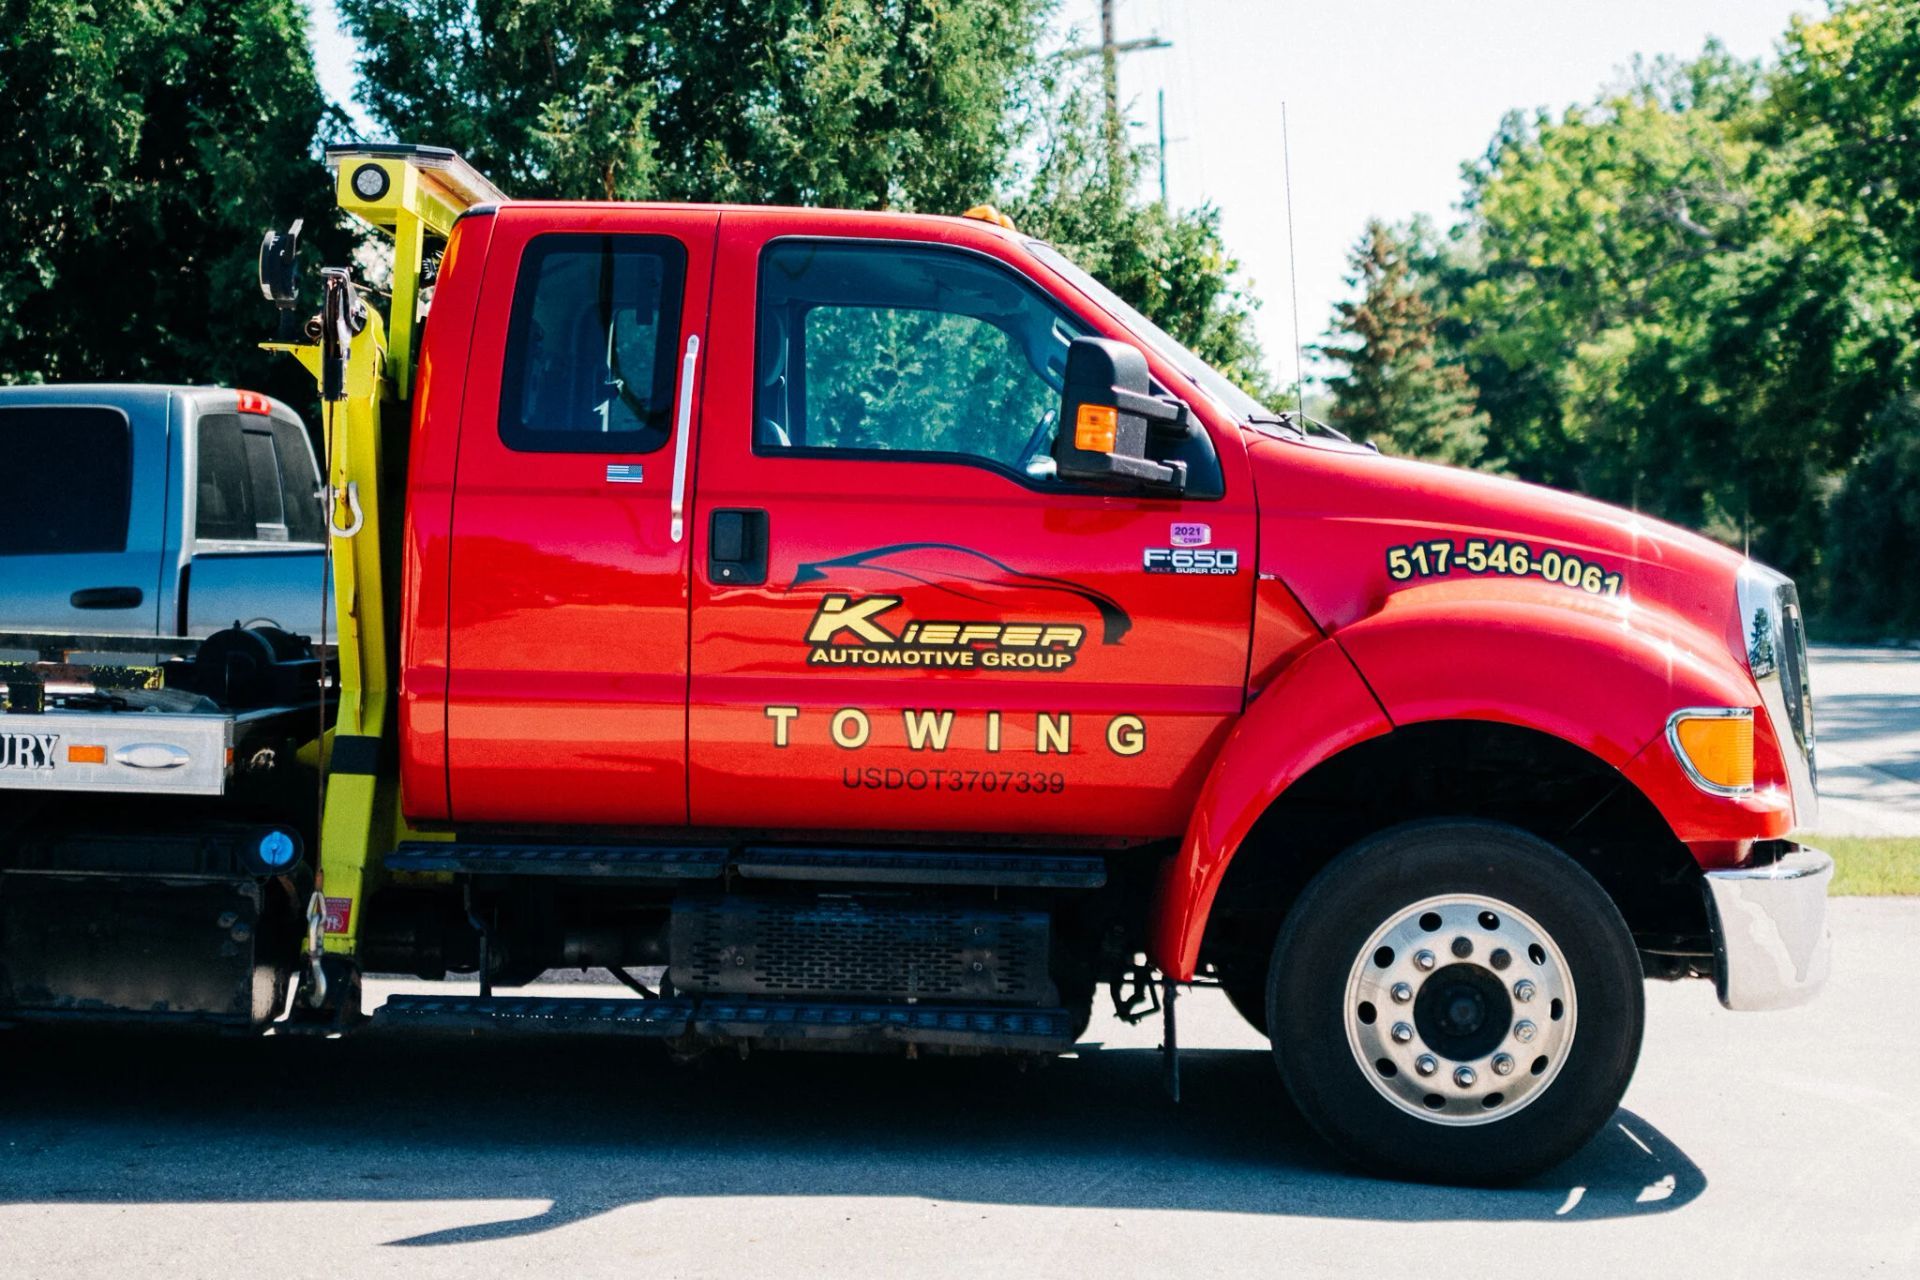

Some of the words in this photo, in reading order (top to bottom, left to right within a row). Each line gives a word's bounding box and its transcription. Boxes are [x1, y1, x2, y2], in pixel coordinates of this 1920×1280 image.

[1174, 526, 1200, 536] 2021
[1388, 541, 1622, 598] 517-546-0061
[811, 649, 974, 667] AUTOMOTIVE
[981, 652, 1073, 669] GROUP
[765, 706, 1145, 756] TOWING
[842, 767, 1065, 794] USDOT3707339
